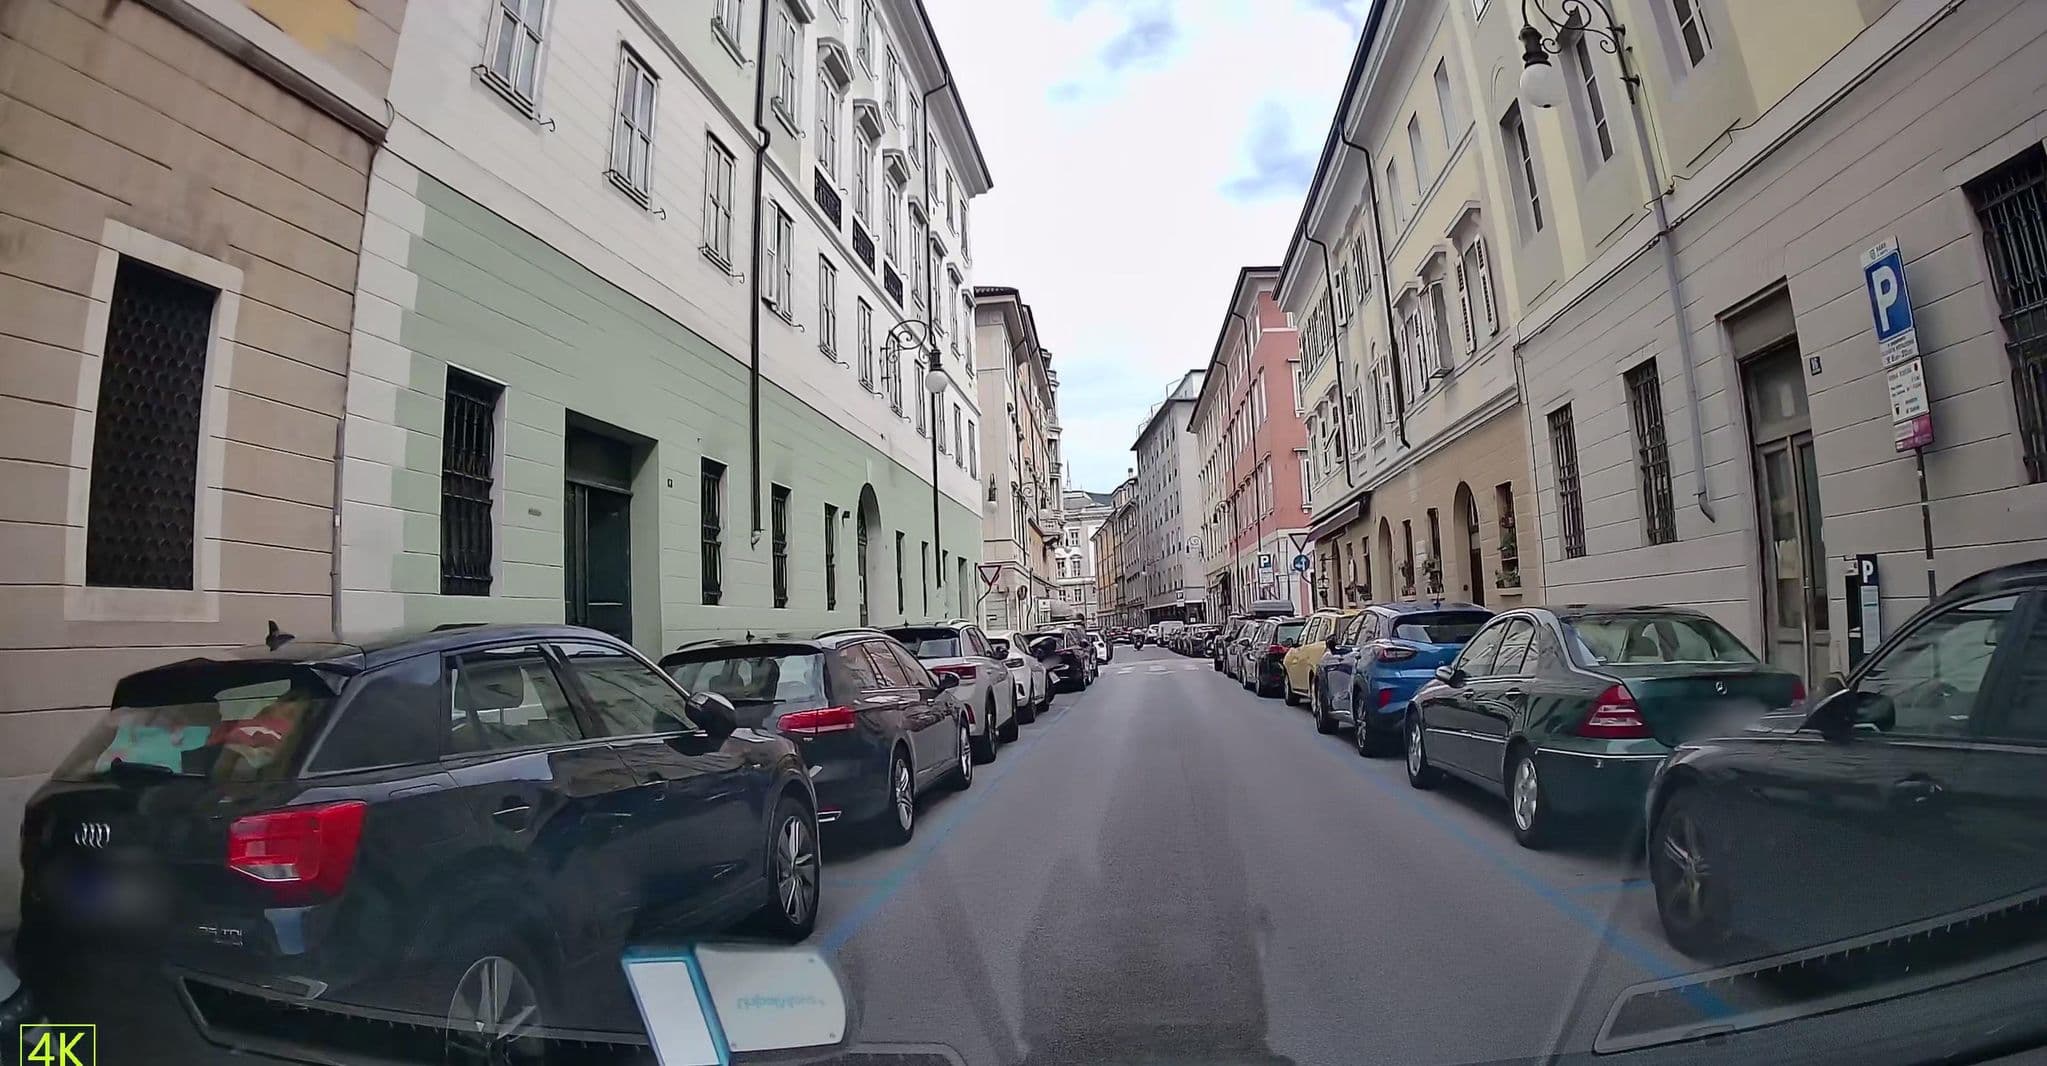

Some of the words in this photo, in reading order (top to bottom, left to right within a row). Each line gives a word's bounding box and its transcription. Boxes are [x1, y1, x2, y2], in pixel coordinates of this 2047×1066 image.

[1871, 266, 1898, 332] P
[1260, 556, 1269, 567] P
[1862, 560, 1874, 583] P
